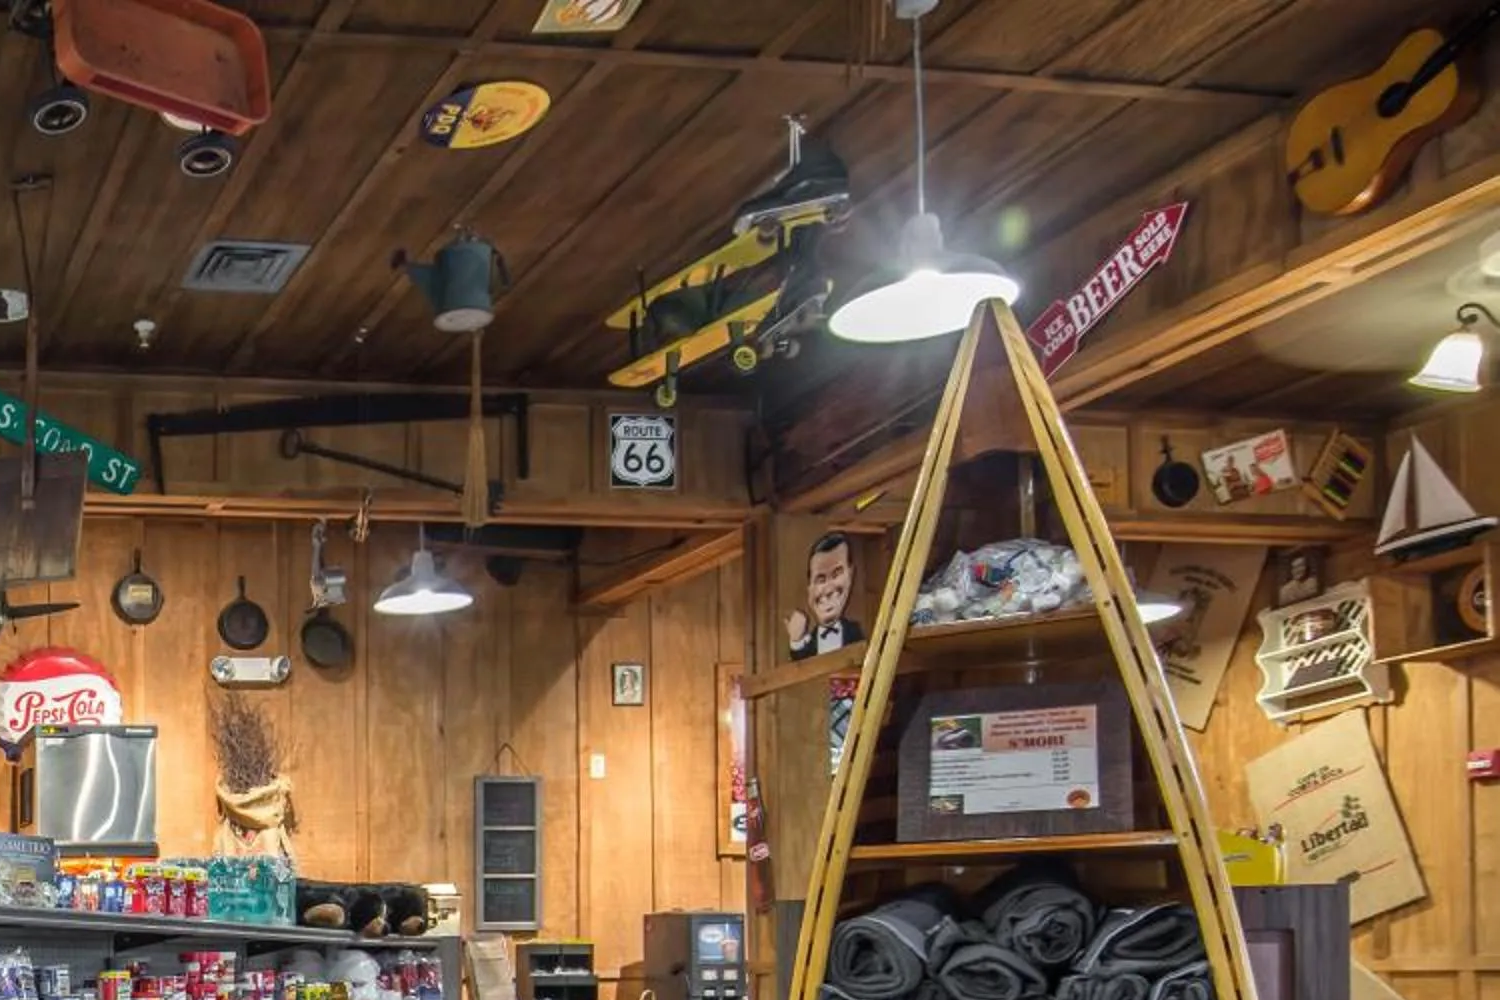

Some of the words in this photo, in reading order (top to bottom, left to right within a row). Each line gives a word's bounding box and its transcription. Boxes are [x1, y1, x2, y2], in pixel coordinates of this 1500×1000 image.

[1134, 212, 1167, 250] SOLD
[1066, 245, 1144, 334] BEER
[1044, 314, 1067, 341] ICE
[1044, 323, 1075, 356] COLD
[623, 425, 664, 437] ROUTE
[102, 458, 137, 489] ST
[623, 442, 665, 474] 66
